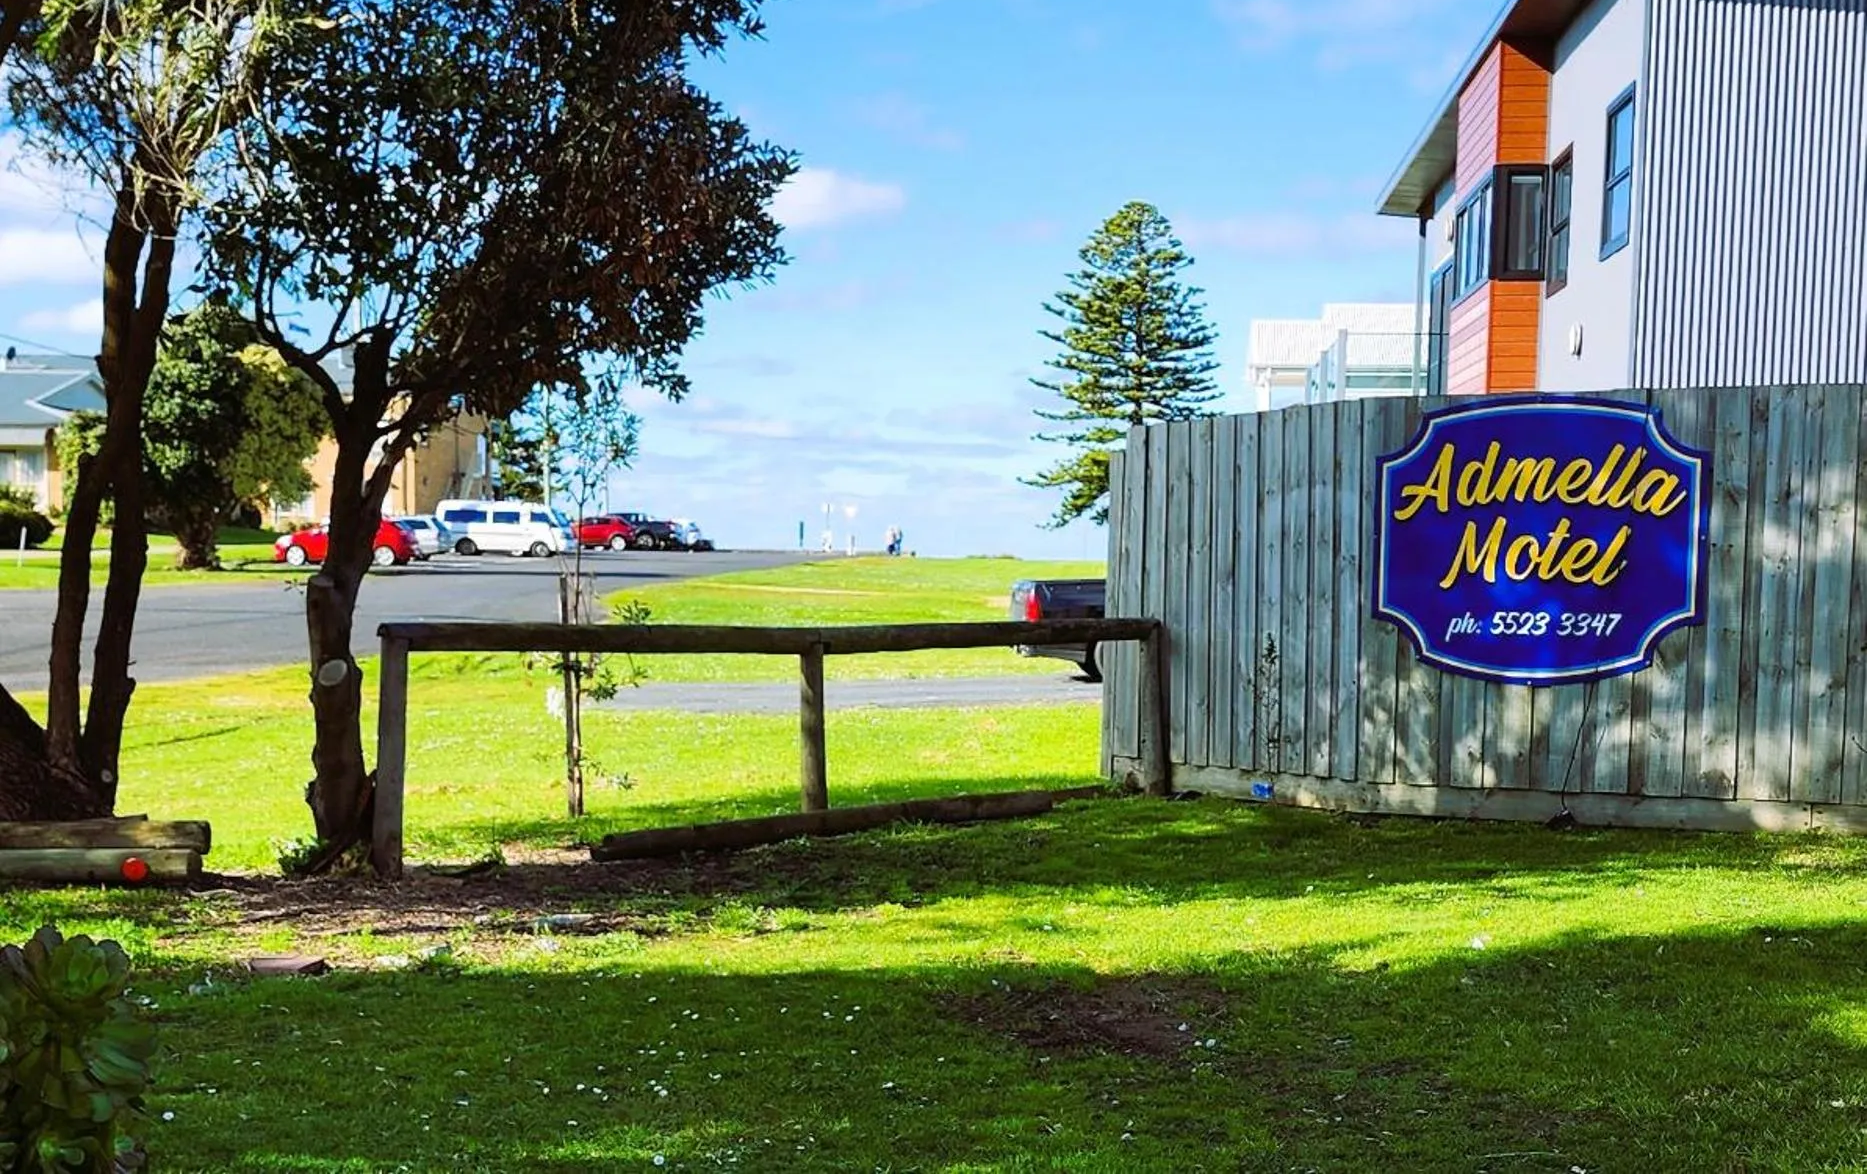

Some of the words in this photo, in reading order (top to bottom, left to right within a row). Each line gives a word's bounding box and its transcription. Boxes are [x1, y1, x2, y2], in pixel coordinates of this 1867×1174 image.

[1394, 441, 1687, 521] Admella
[1439, 516, 1632, 589] Motel
[1489, 611, 1550, 637] 5523
[1556, 613, 1622, 637] 3347
